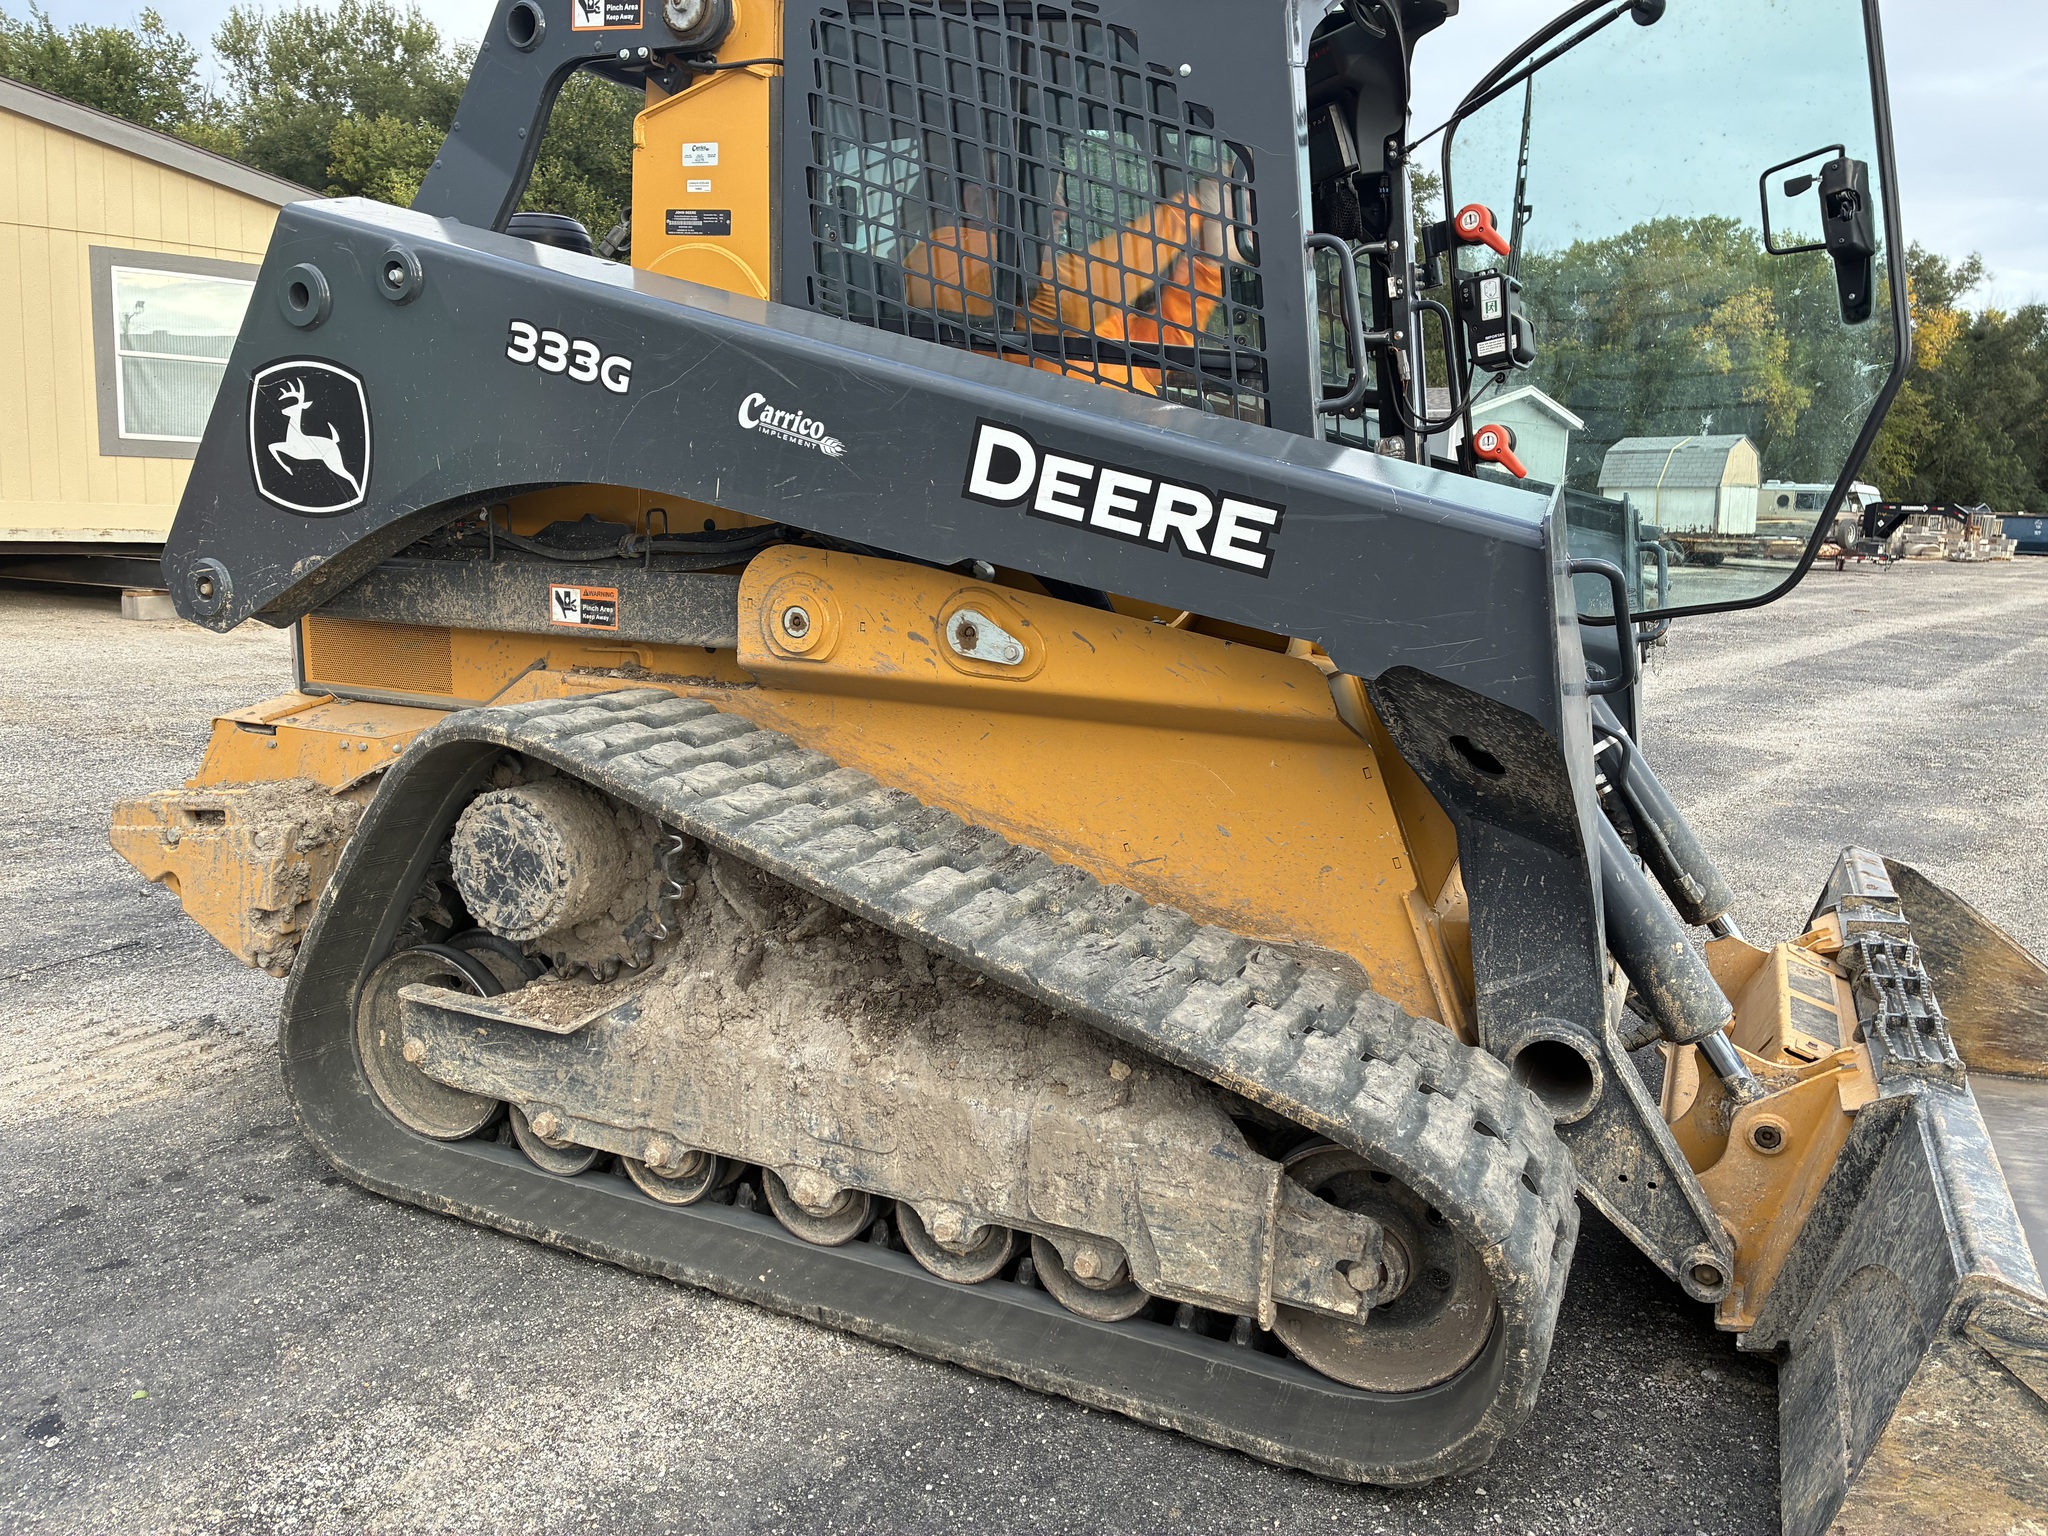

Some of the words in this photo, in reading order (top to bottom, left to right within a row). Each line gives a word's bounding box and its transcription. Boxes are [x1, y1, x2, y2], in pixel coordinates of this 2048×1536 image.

[624, 3, 639, 11] Area
[1484, 332, 1505, 340] IMPORTAN
[506, 320, 633, 394] 333G
[738, 392, 825, 439] Carrico
[758, 426, 817, 450] IMPLEMENT
[967, 423, 1279, 571] DEERE
[589, 590, 615, 598] WARNING
[582, 604, 599, 612] Pinch
[600, 605, 614, 613] Area
[582, 613, 595, 621] Keep
[596, 614, 610, 622] Away
